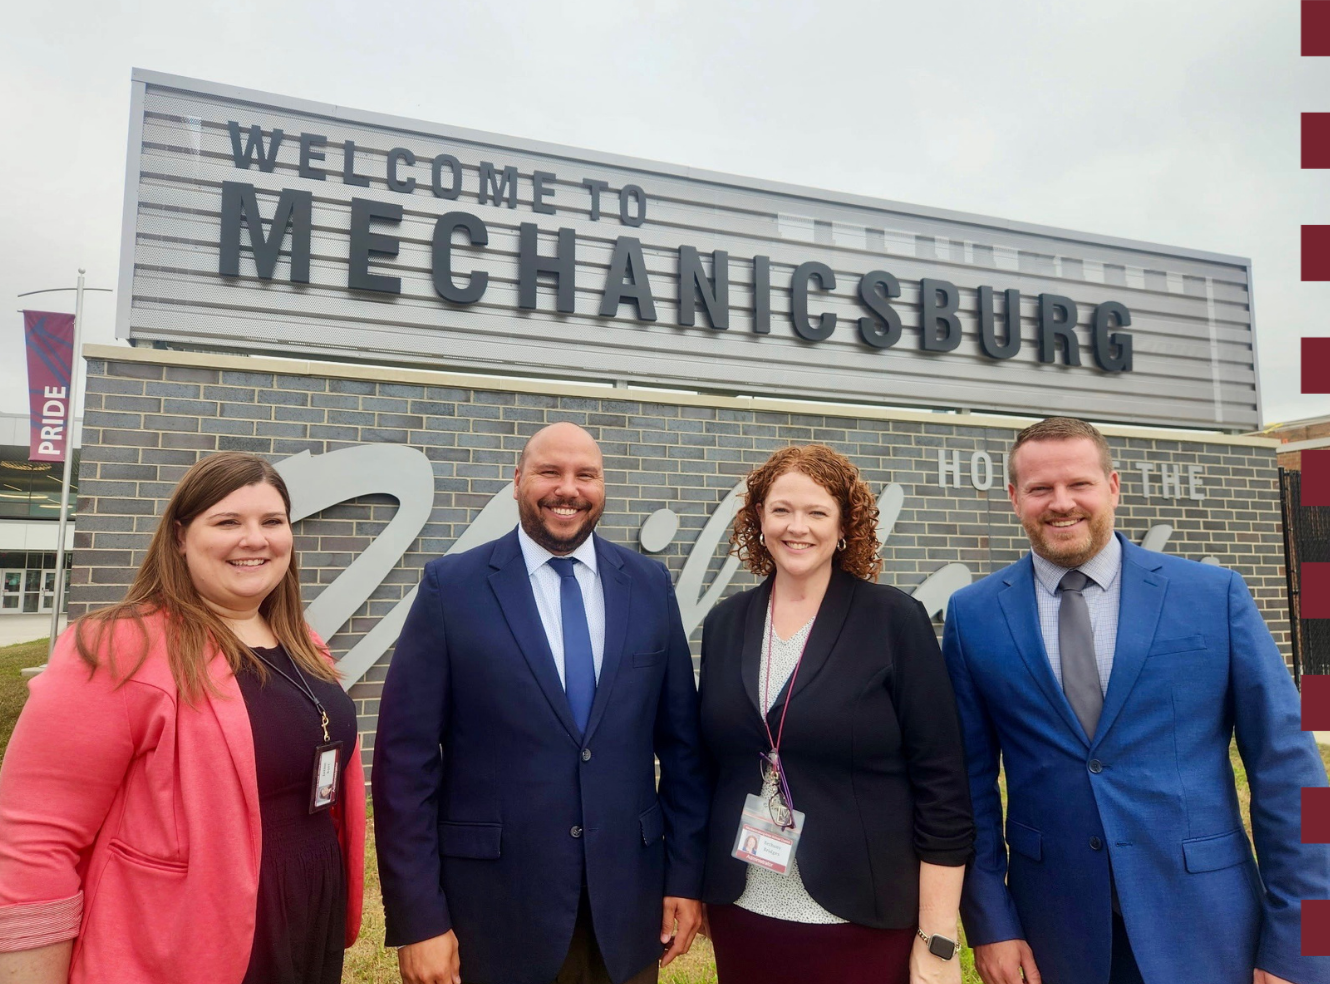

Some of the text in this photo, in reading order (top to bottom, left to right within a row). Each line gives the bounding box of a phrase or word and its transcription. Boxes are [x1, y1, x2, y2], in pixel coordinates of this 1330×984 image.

[228, 120, 647, 228] WELCOME TO
[219, 180, 1134, 373] MECHANICSBURG
[38, 386, 66, 455] PRIDE
[938, 450, 1205, 501] HO THE
